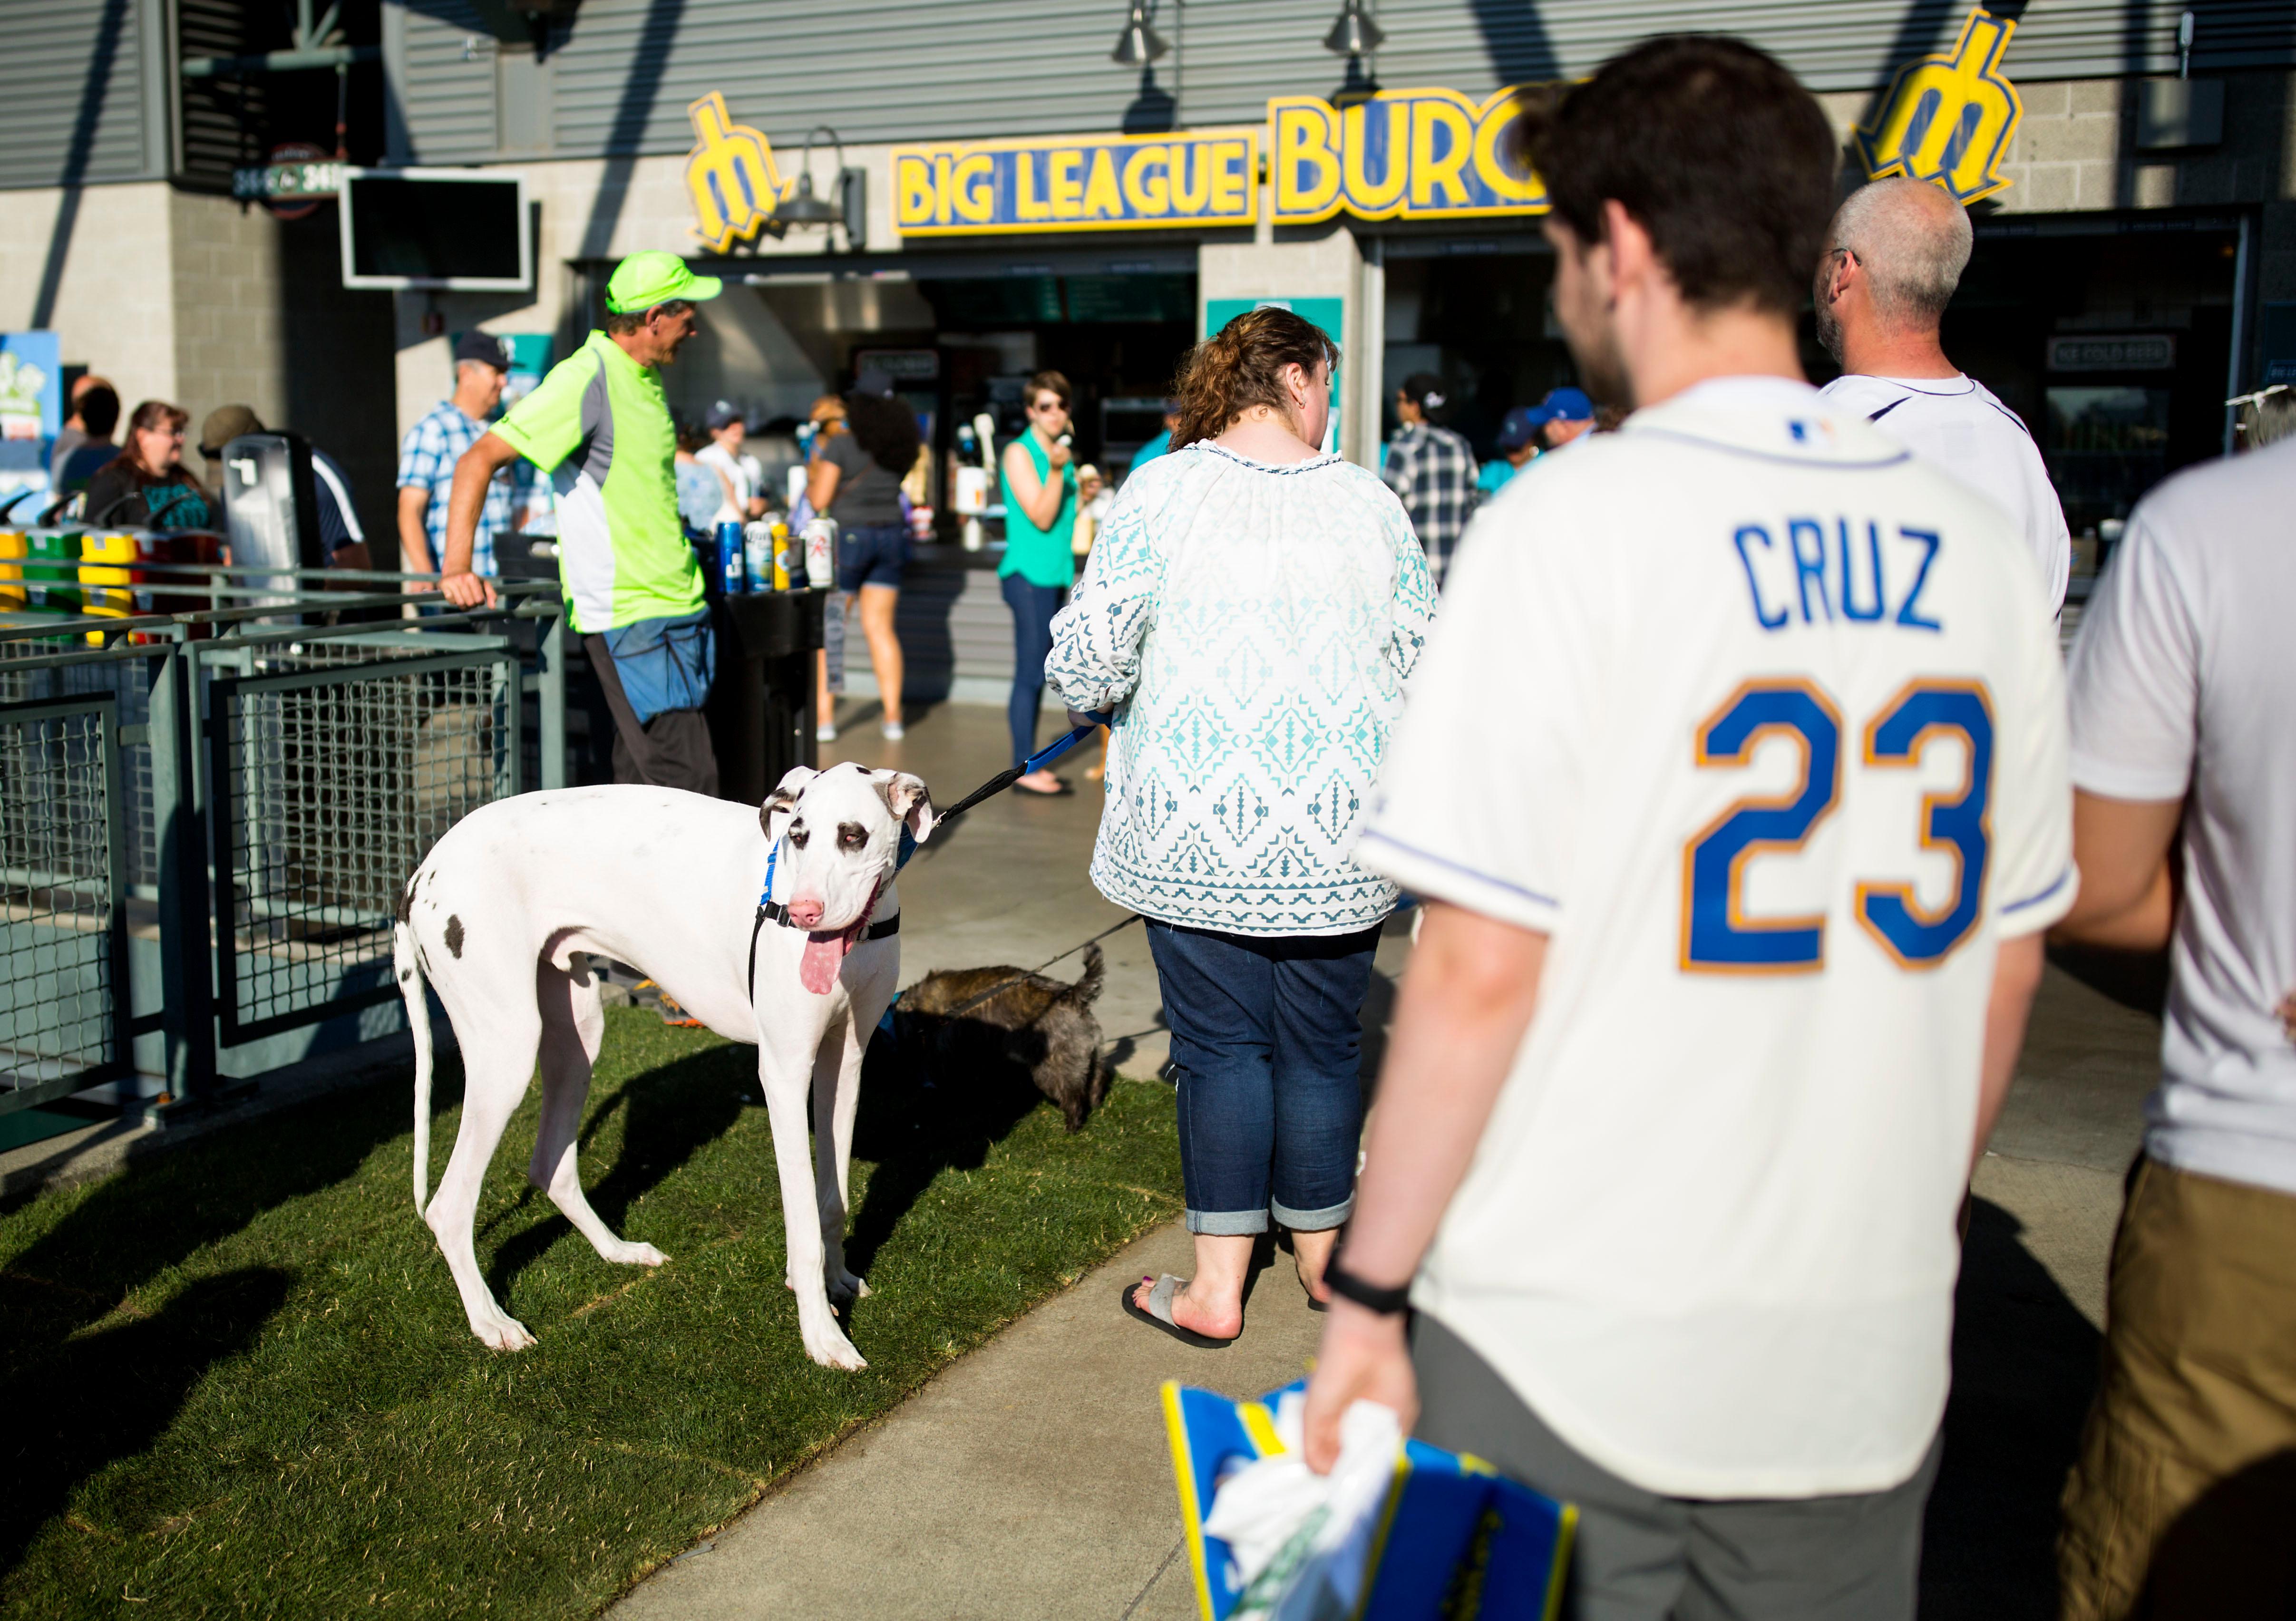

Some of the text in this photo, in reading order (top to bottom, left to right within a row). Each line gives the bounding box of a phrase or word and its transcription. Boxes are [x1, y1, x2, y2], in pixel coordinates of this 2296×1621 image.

[899, 154, 994, 224] BIG
[1015, 142, 1246, 220] LEAGUE
[1733, 515, 1943, 633] CRUZ
[1679, 676, 1996, 976] 23
